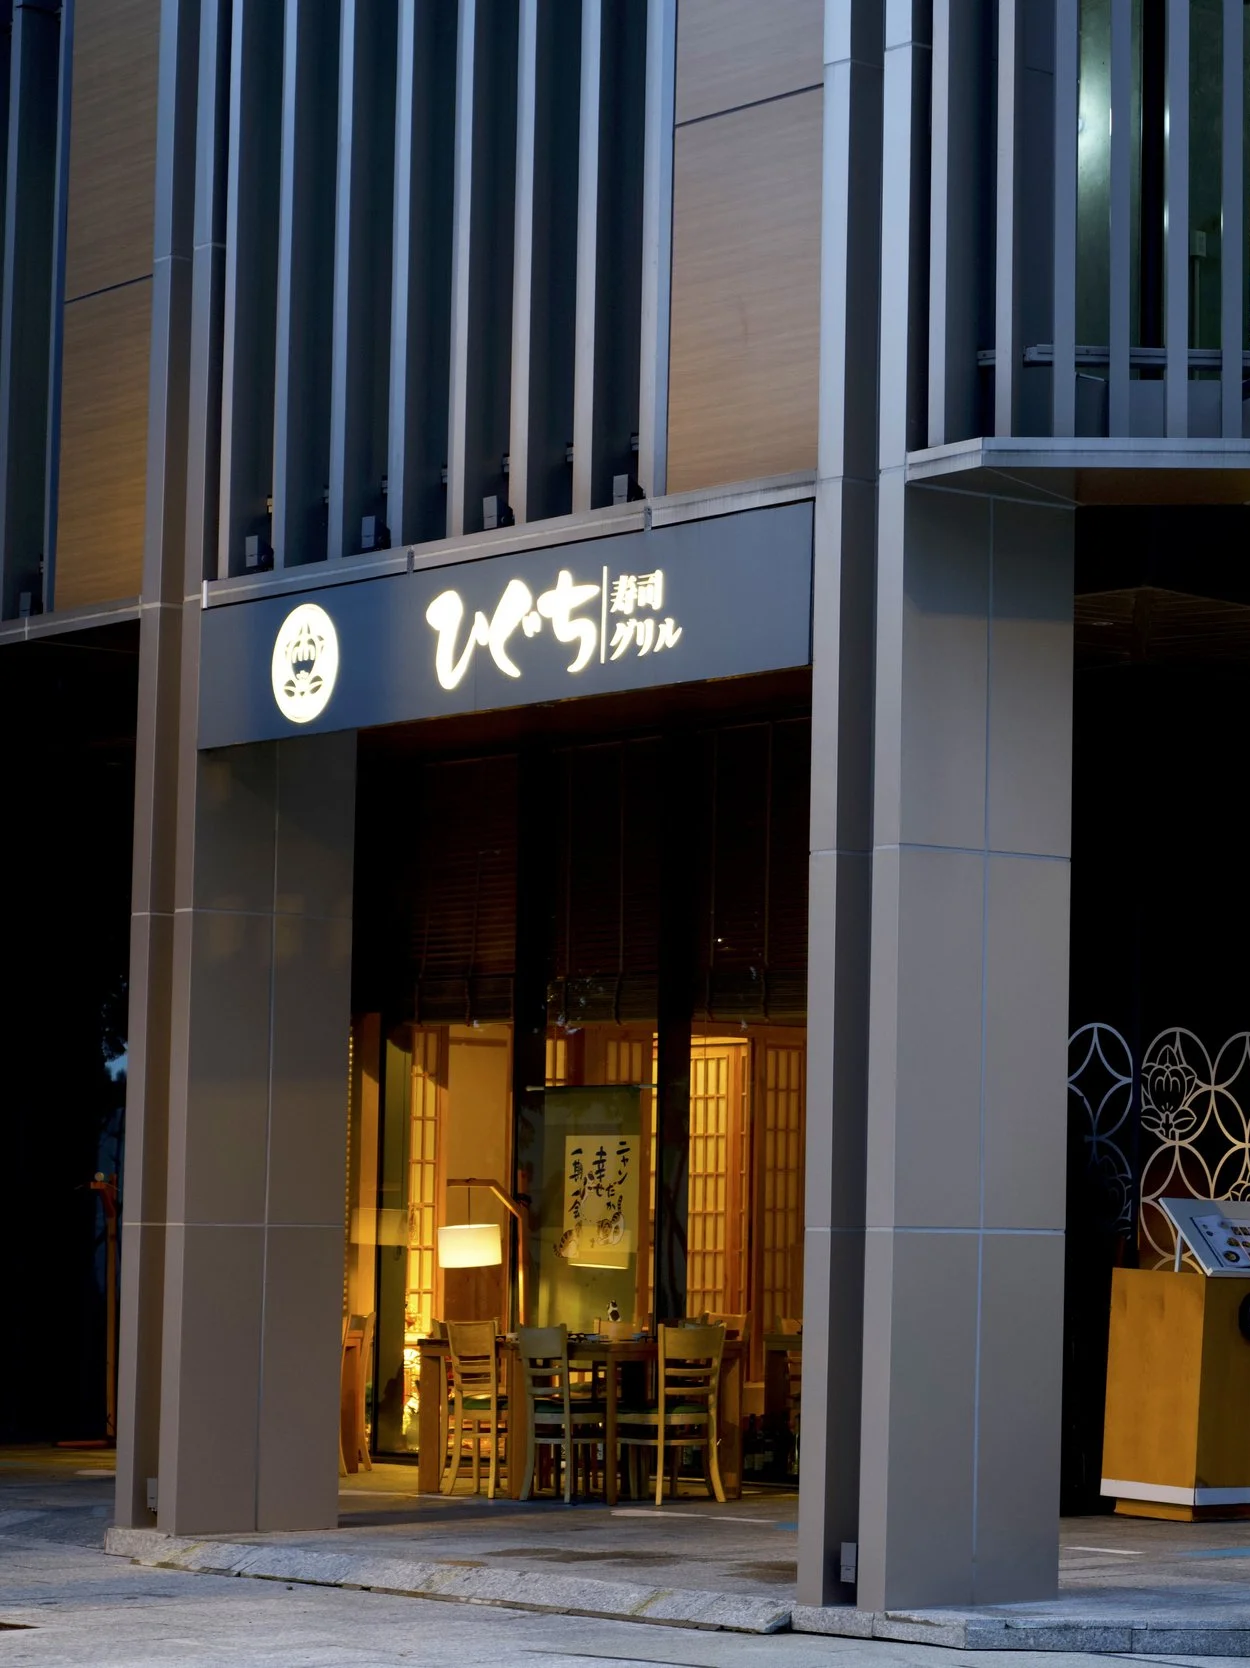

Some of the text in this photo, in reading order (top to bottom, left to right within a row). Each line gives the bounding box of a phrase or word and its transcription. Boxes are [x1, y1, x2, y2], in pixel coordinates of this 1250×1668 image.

[610, 569, 664, 616] 寿司
[426, 570, 601, 691] ひぐち
[610, 617, 683, 661] グリル
